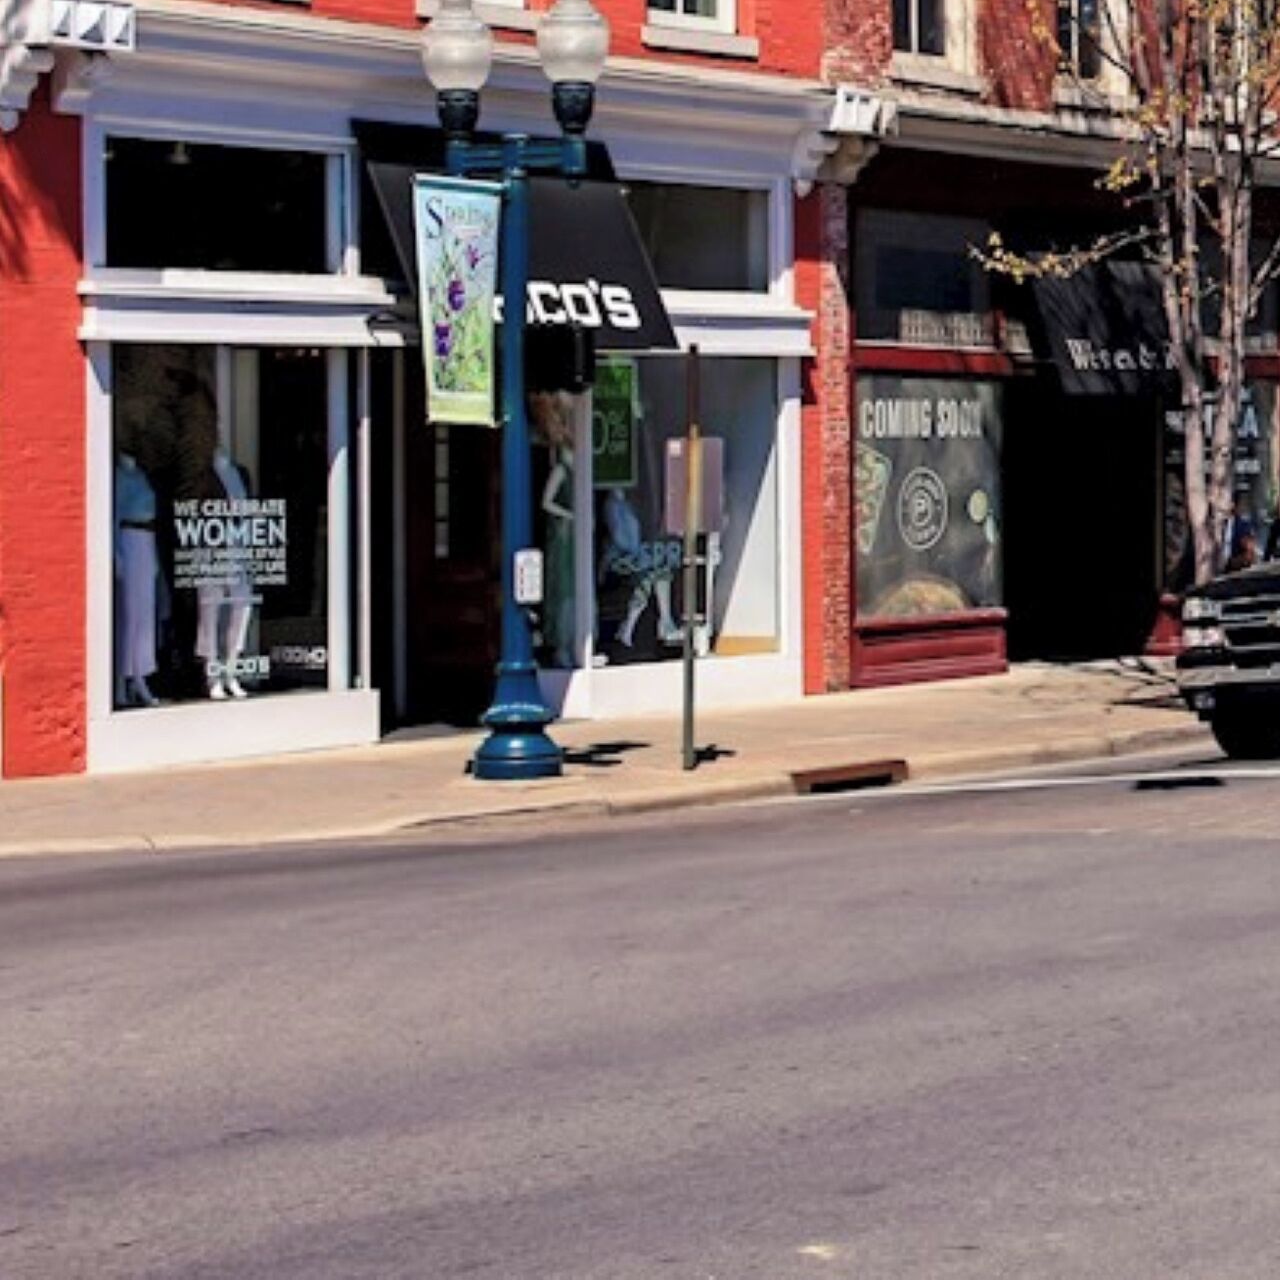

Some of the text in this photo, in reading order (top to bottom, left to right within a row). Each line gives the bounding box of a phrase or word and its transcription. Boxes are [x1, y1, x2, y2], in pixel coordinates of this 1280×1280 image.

[861, 400, 931, 438] COMING
[174, 499, 286, 517] WE CELEBRATE
[174, 519, 286, 546] WOMEN
